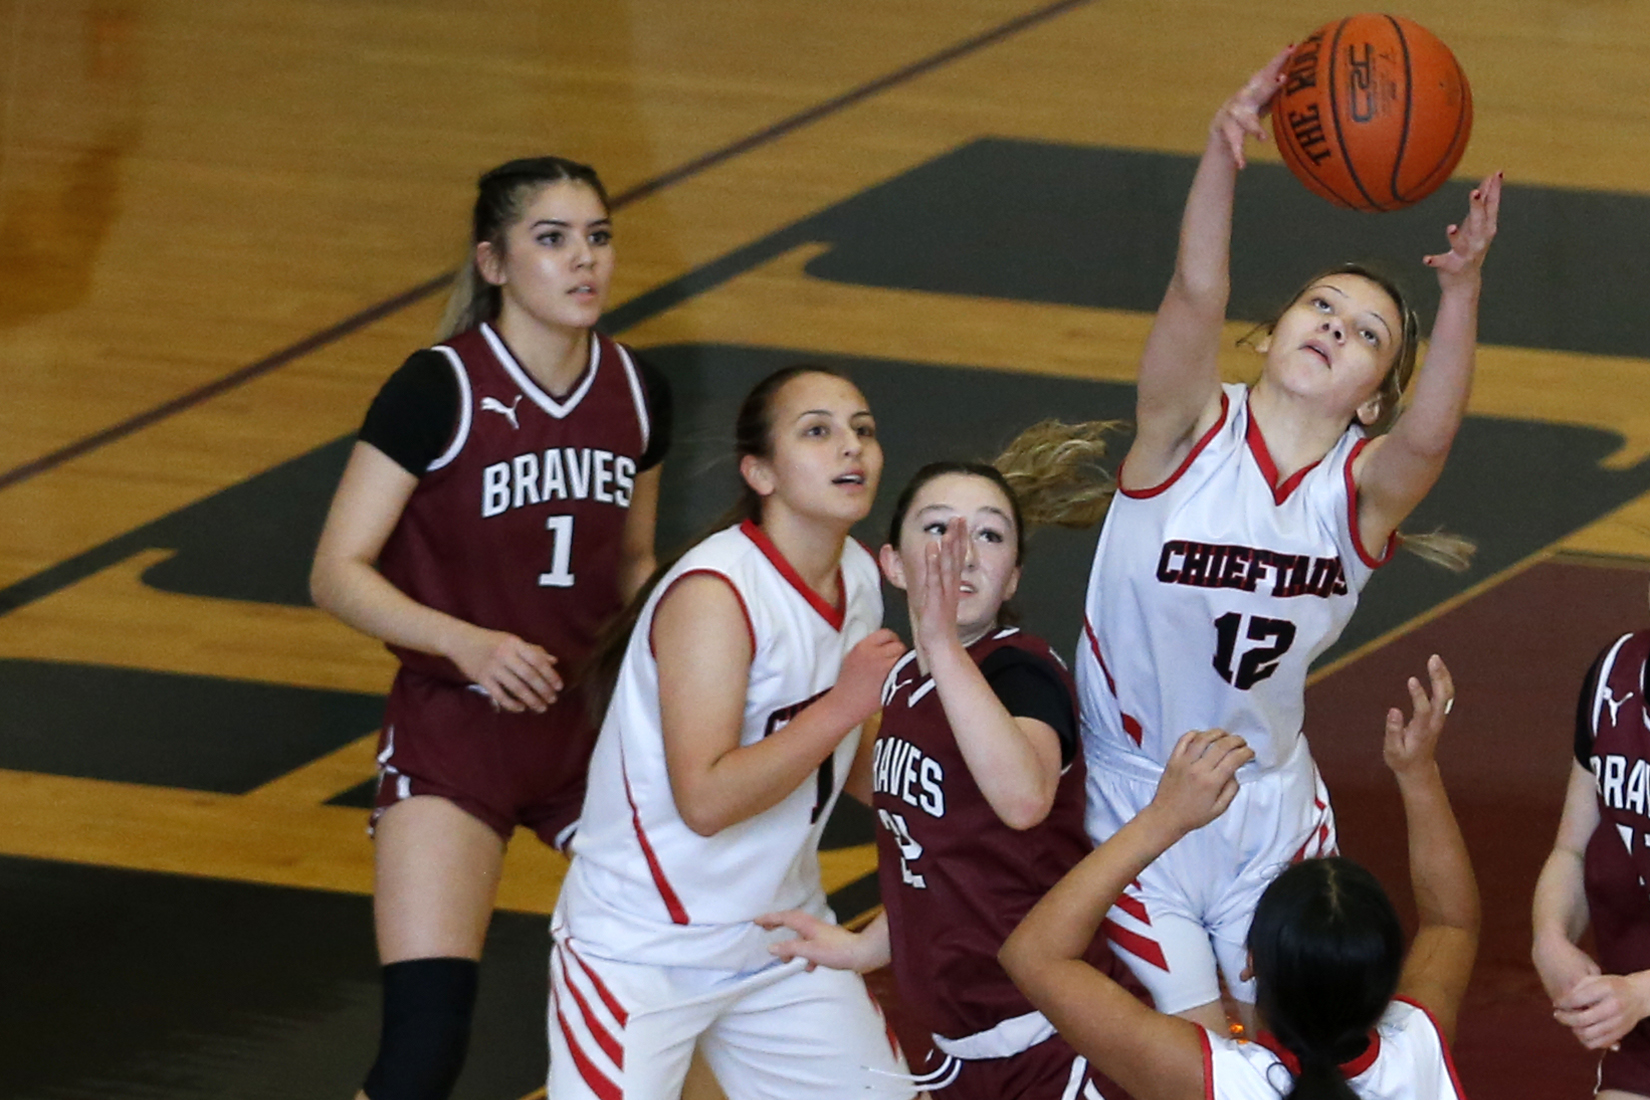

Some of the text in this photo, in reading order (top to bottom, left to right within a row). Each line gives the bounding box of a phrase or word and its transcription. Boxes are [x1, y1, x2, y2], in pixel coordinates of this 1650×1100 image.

[1288, 104, 1331, 166] THE
[481, 447, 637, 518] BRAVES
[537, 515, 575, 587] 1
[1212, 611, 1297, 691] 12
[873, 736, 945, 819] RAVES
